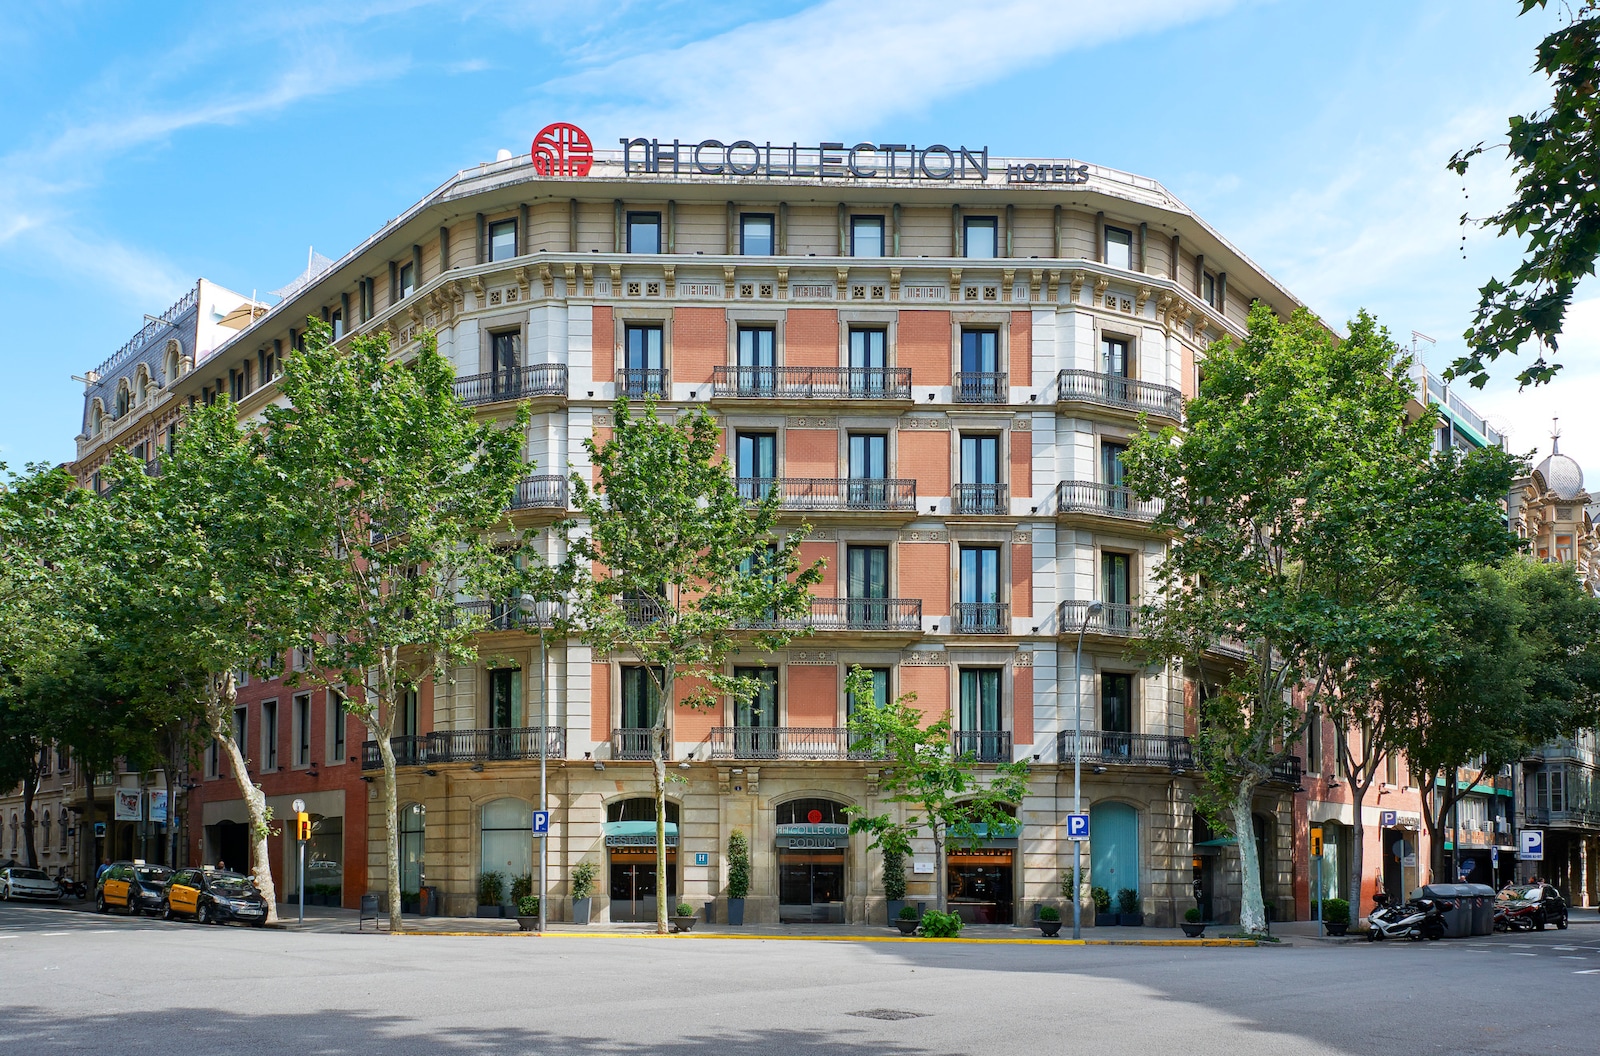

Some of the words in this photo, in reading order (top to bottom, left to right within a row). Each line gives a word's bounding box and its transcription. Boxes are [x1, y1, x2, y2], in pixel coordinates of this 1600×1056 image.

[694, 139, 988, 181] COLLECTION
[1007, 163, 1090, 184] HOTELS
[535, 813, 546, 831] P
[1071, 816, 1085, 835] P
[1384, 812, 1394, 824] P
[606, 836, 678, 844] RESTAURNT
[789, 838, 836, 848] PODIUM
[1522, 832, 1540, 852] P
